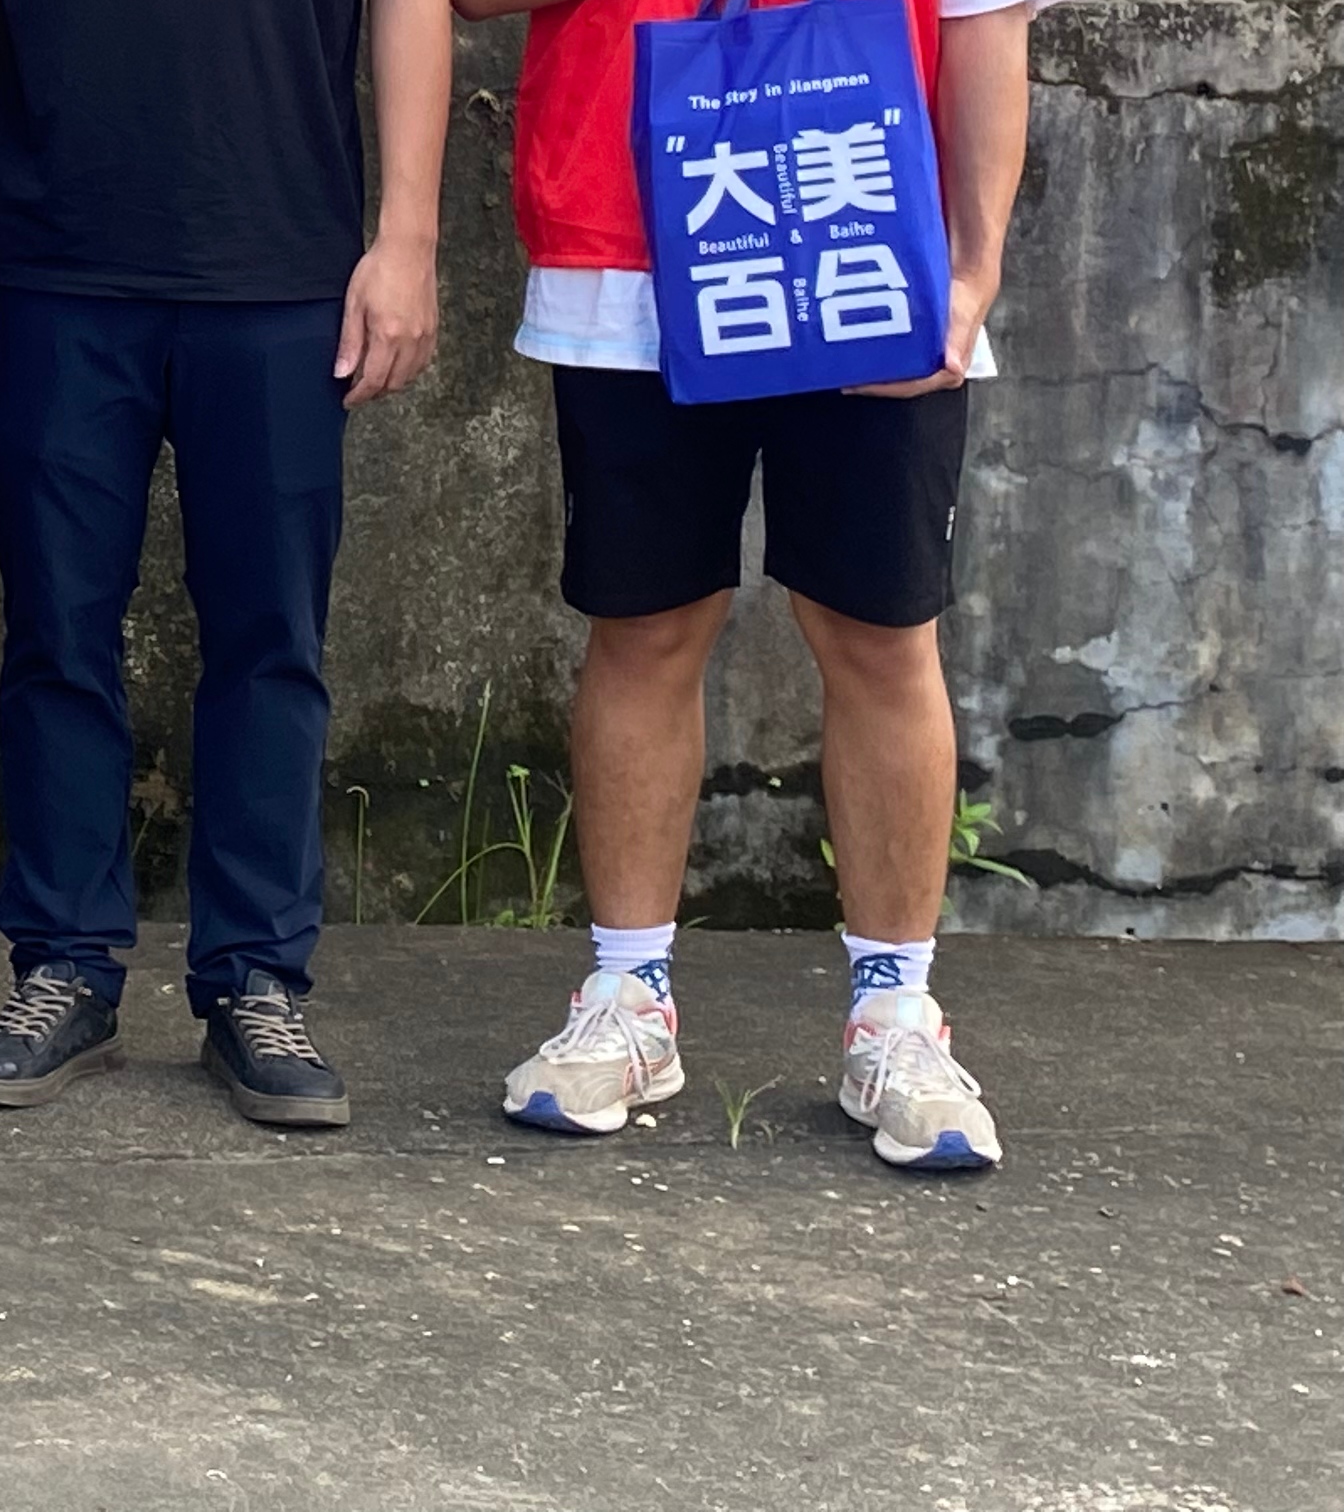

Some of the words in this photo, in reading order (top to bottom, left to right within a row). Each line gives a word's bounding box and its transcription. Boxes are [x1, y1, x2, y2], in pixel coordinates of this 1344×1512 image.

[688, 95, 721, 110] The
[765, 82, 782, 97] in
[789, 73, 870, 95] Jiangmen
[773, 143, 797, 215] Beautiful
[699, 232, 770, 256] Beautiful
[790, 229, 803, 244] &
[828, 221, 876, 239] Baihe
[689, 244, 913, 356] 百合
[792, 278, 810, 322] Baihe
